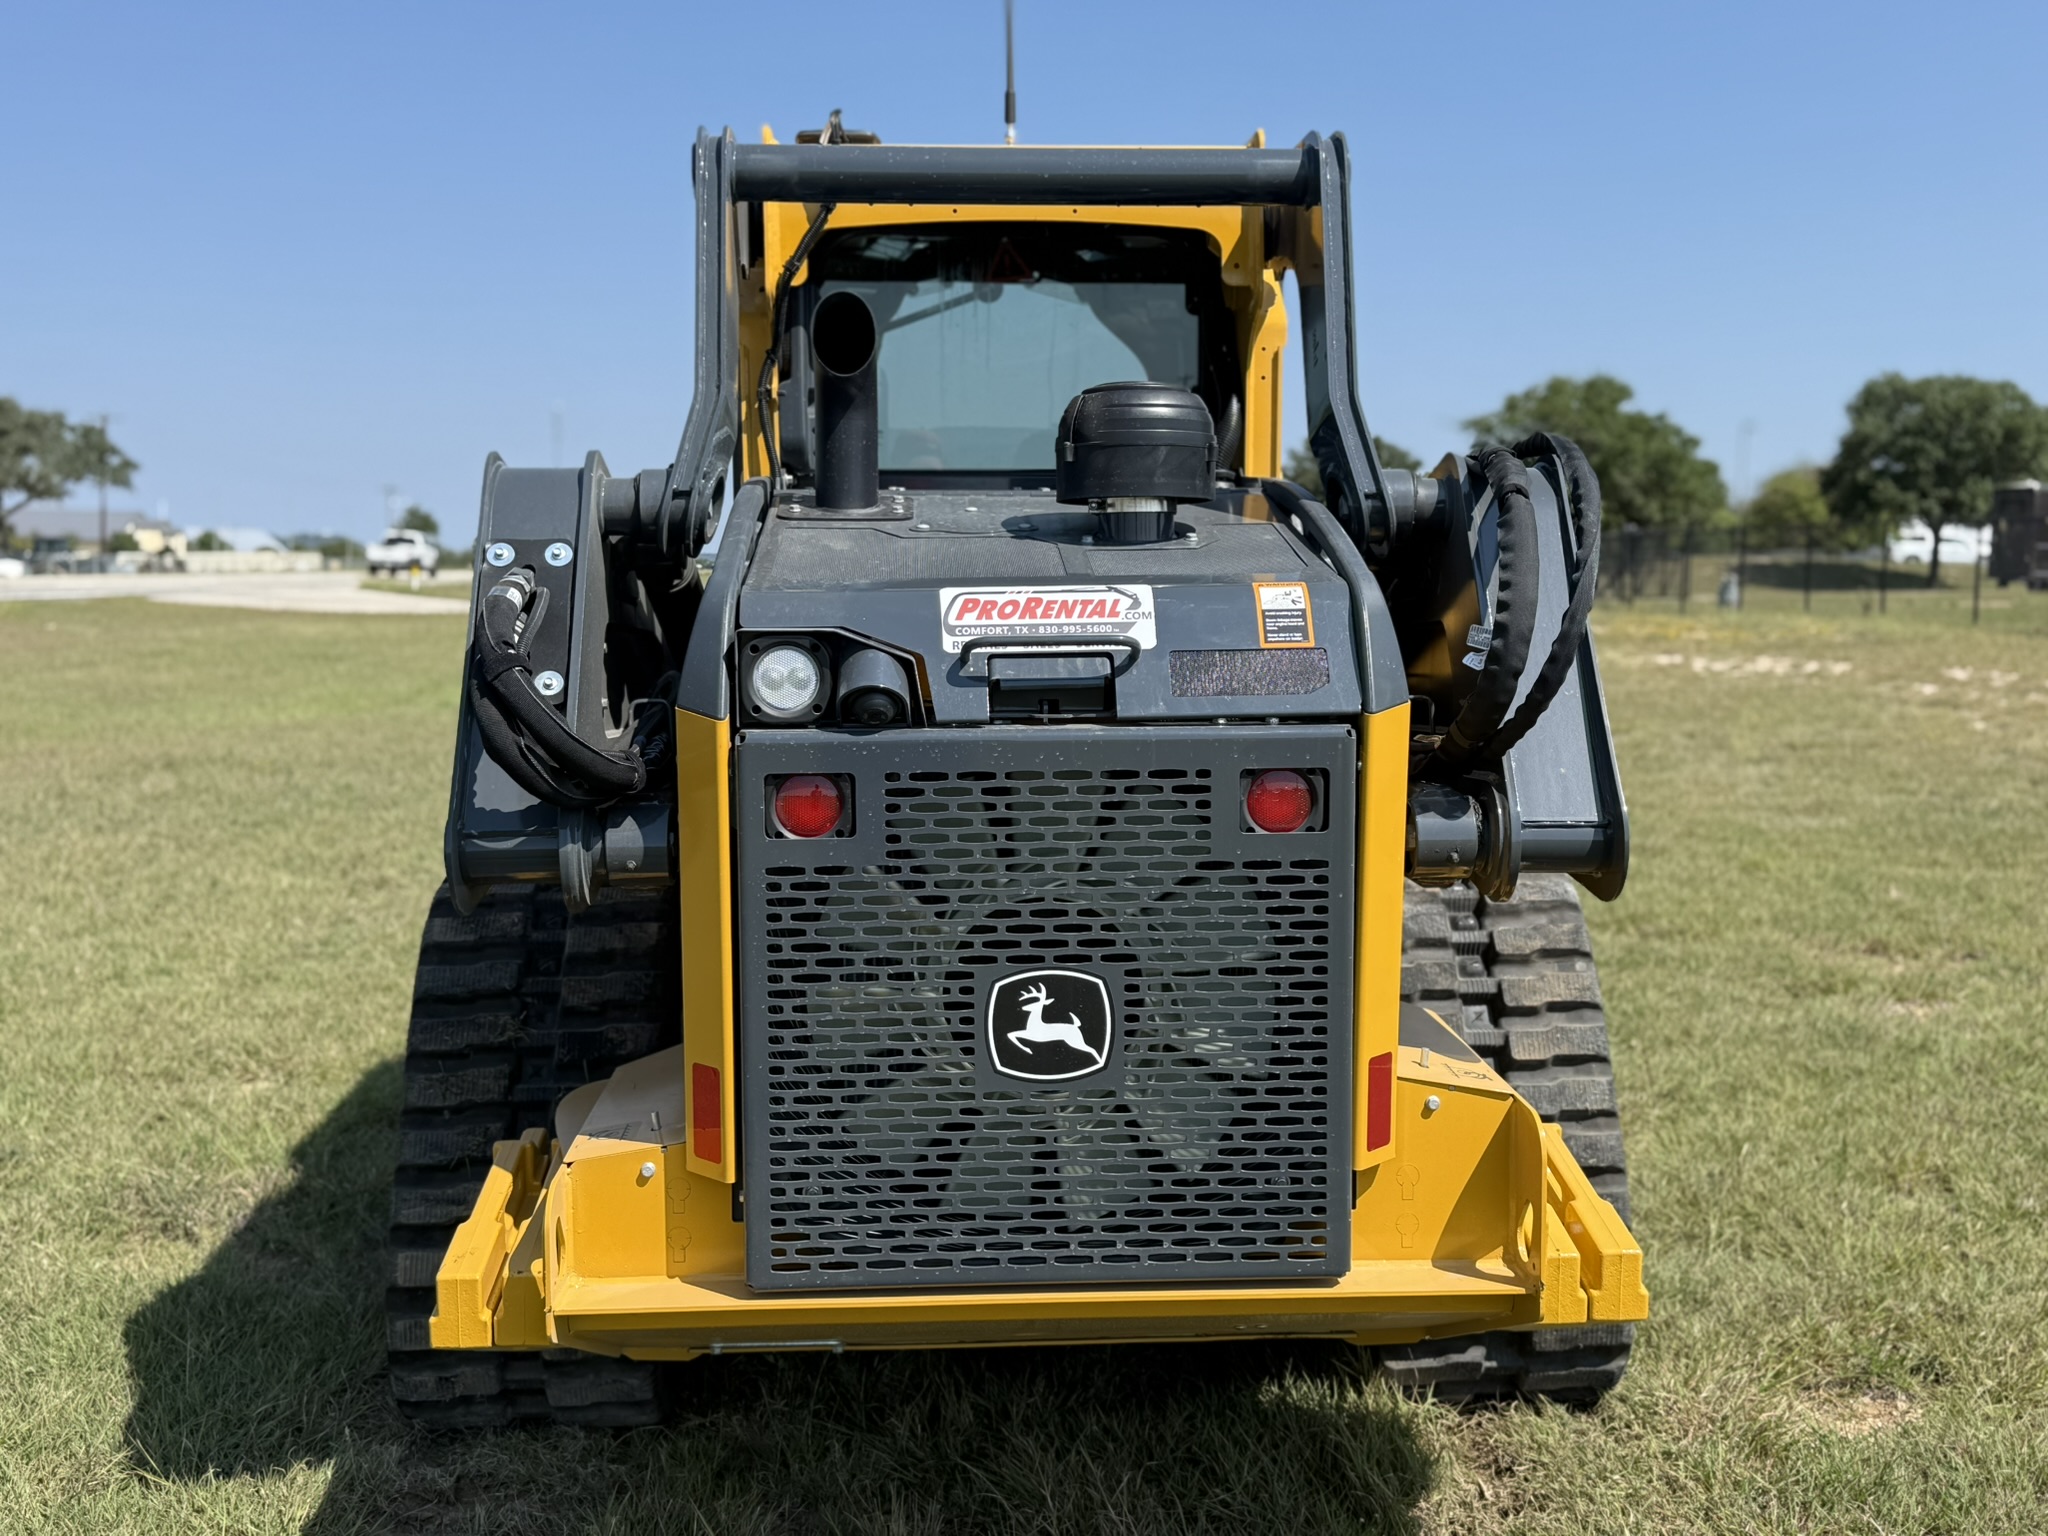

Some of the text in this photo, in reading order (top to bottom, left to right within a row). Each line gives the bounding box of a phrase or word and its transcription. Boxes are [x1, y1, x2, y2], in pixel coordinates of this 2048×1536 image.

[955, 624, 1113, 636] COMFORT, TX 830-995-5600
